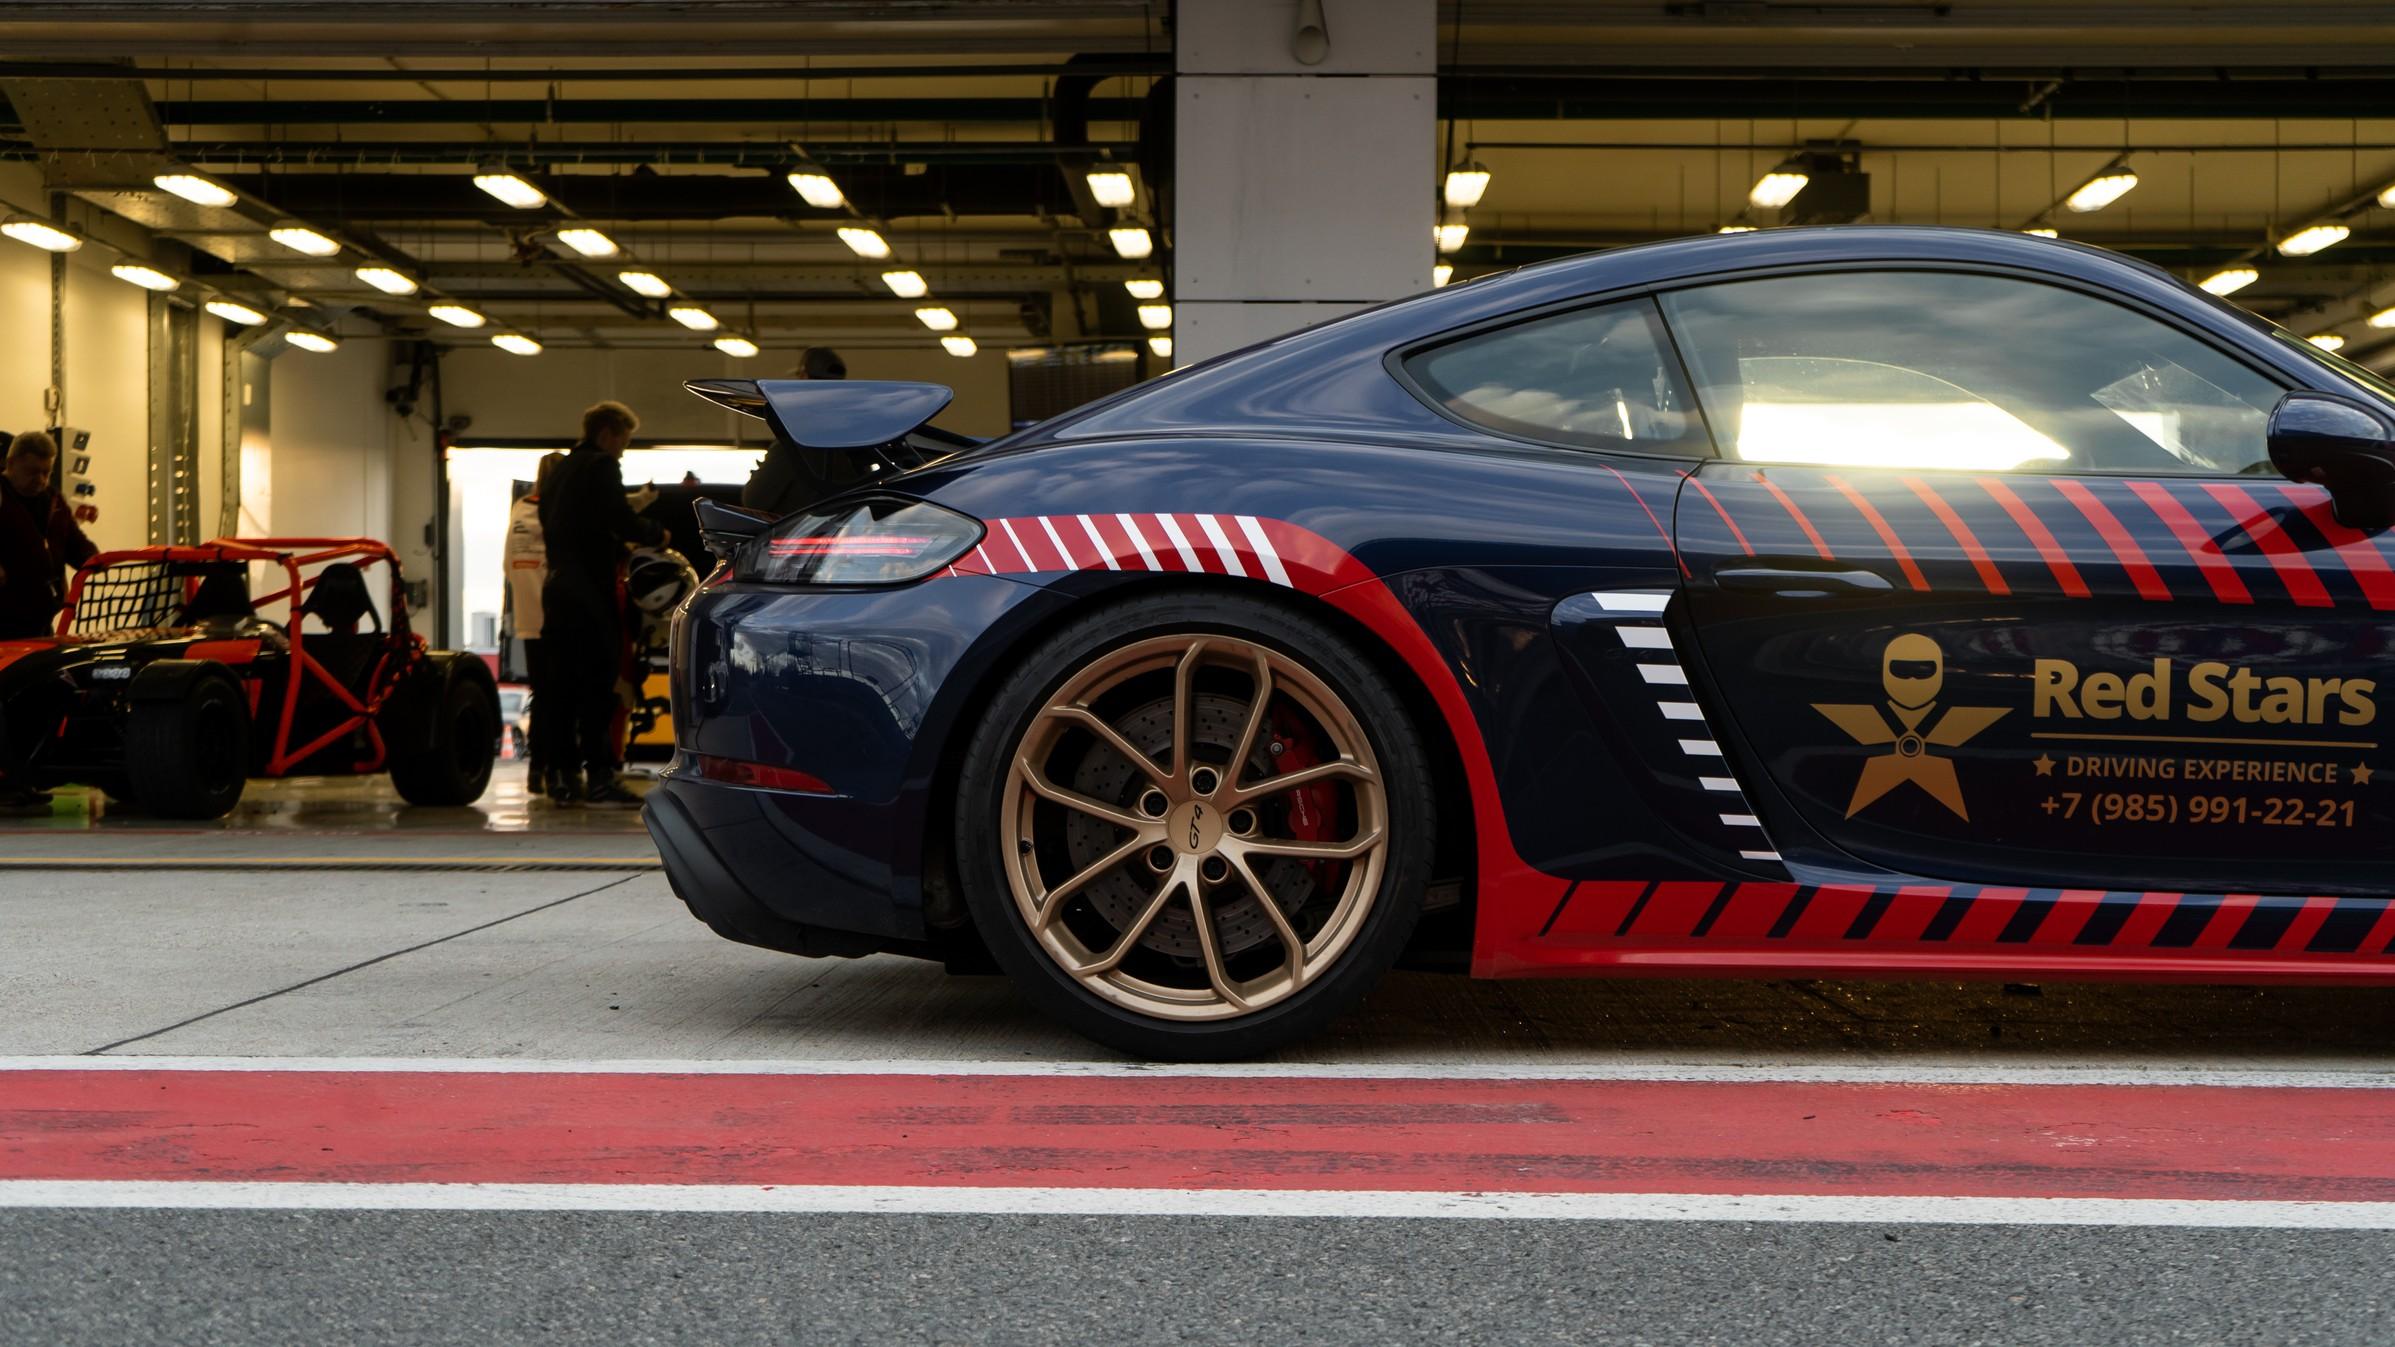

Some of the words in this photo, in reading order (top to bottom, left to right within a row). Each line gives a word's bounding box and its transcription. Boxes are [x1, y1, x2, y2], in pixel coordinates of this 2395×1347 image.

[2032, 657, 2171, 721] Red
[2187, 661, 2377, 726] Stars
[2067, 756, 2176, 779] DRIVING
[2184, 759, 2338, 783] EXPERIENCE
[1189, 803, 1204, 850] GT4
[2041, 792, 2082, 819] +7
[2091, 793, 2178, 825] (985)
[2188, 795, 2355, 827] 991-22-21
